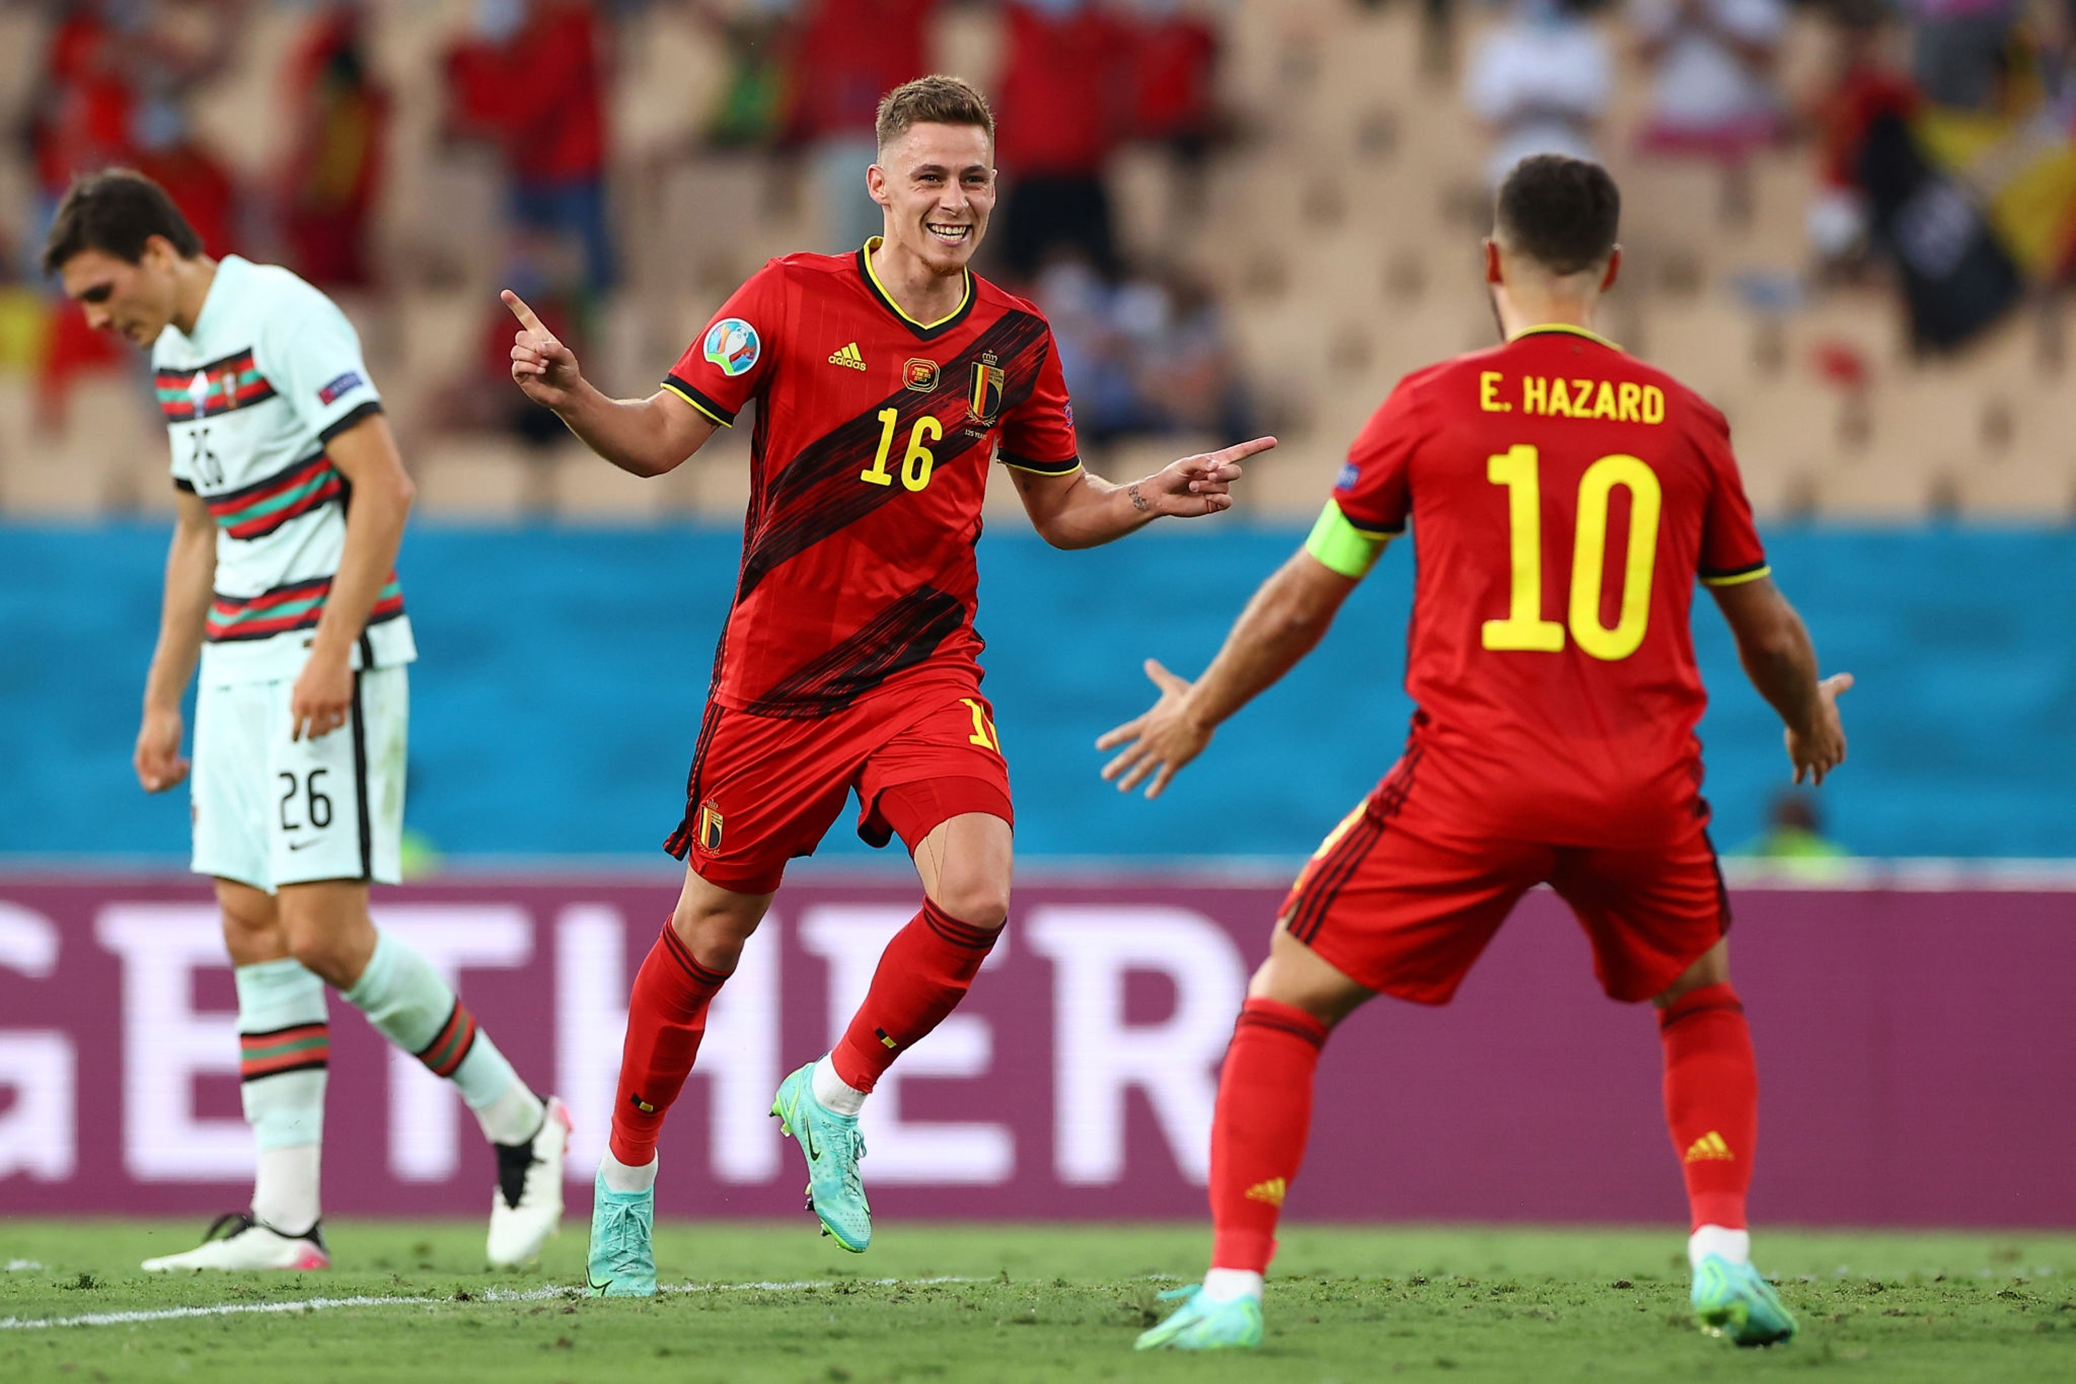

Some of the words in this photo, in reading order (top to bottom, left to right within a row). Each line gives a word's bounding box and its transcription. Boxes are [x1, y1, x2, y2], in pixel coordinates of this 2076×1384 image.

[828, 355, 867, 371] adidas
[1480, 371, 1512, 412] E.
[1523, 375, 1665, 425] HAZARD
[860, 407, 943, 492] 16
[1482, 444, 1662, 661] 10
[959, 698, 1001, 755] 1
[279, 767, 332, 831] 26
